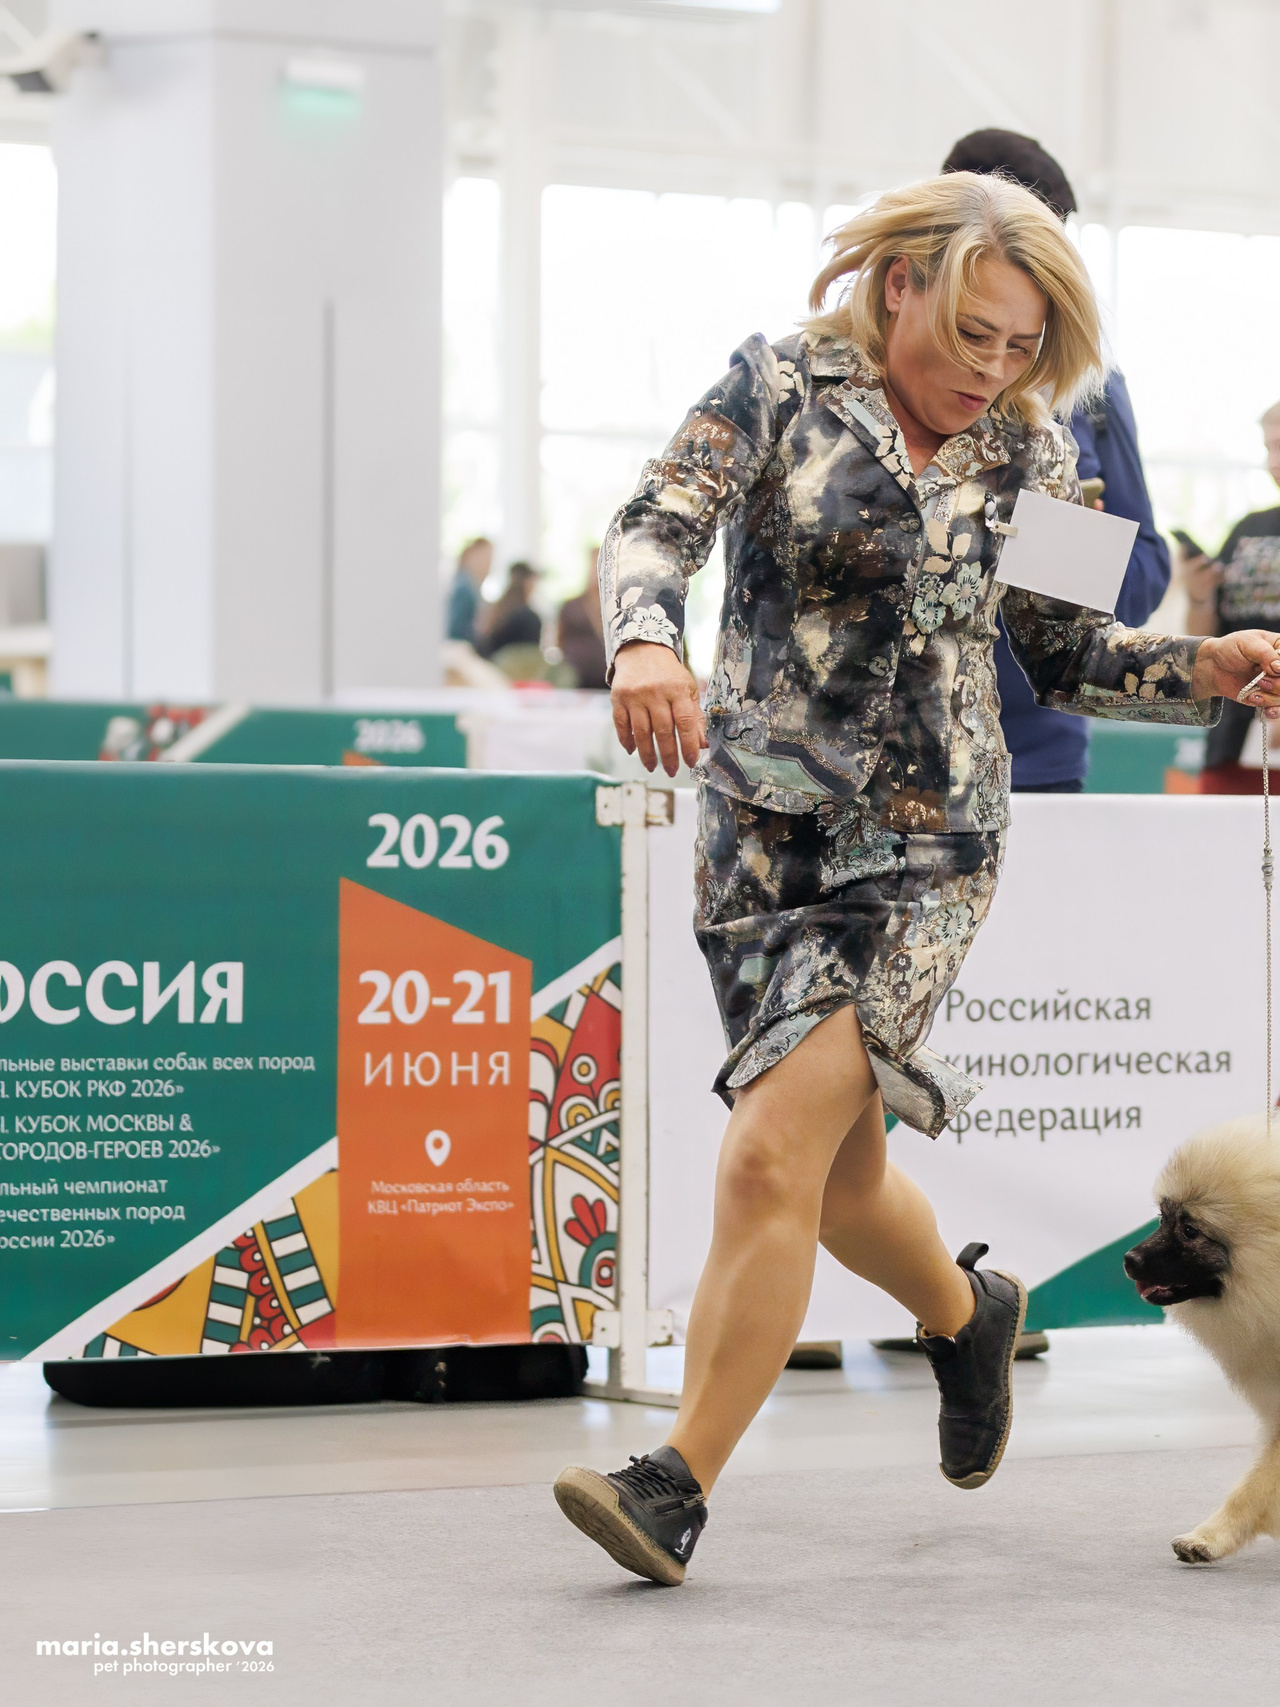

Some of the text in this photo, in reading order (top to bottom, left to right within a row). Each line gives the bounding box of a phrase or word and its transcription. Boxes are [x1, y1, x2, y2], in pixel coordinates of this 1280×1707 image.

[367, 813, 509, 869] 2026
[358, 970, 510, 1024] 20-21
[944, 987, 1151, 1022] Российская
[61, 1058, 148, 1071] выставки
[153, 1052, 207, 1070] собак
[213, 1057, 253, 1070] всех
[259, 1057, 315, 1074] пород
[365, 1051, 509, 1086] ИЮНЯ
[16, 1080, 81, 1098] КУБОК
[88, 1080, 126, 1097] РКФ
[131, 1079, 183, 1097] 2026»
[15, 1115, 81, 1133] КУБОК
[87, 1114, 174, 1132] МОСКВЫ
[179, 1114, 193, 1131] &
[948, 1105, 1141, 1144] федерация
[0, 1140, 163, 1162] ОРОДОВ-ГЕРОЕВ
[64, 1180, 168, 1194] чемпионат
[372, 1178, 509, 1194] Московская область
[126, 1206, 185, 1224] пород
[368, 1200, 398, 1215] КВЦ
[60, 1230, 115, 1247] 2026»
